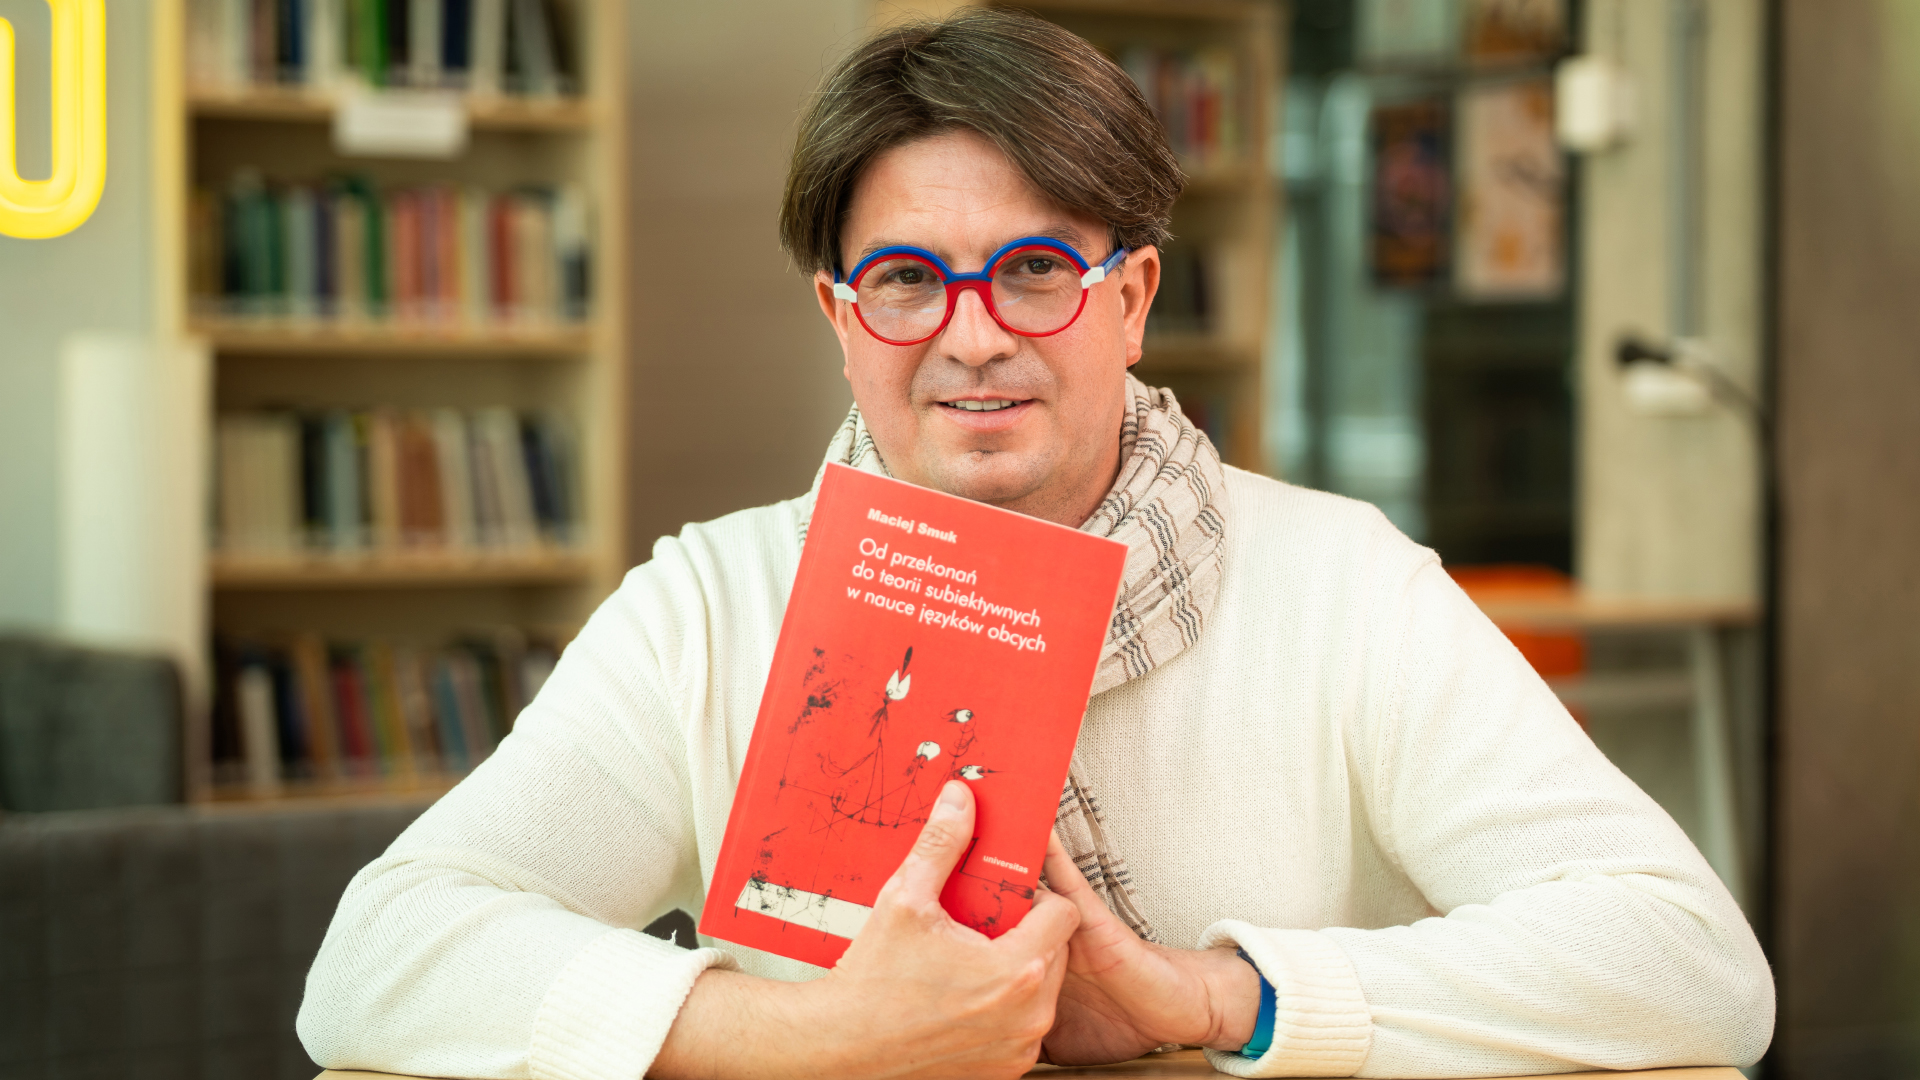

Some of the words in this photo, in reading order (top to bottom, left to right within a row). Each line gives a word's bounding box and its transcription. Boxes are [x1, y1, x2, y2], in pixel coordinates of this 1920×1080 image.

[867, 508, 915, 534] Maciej
[917, 521, 958, 544] Smuk
[859, 537, 889, 560] Od
[890, 551, 978, 586] przekonań
[852, 560, 875, 580] do
[879, 569, 922, 593] teorii
[924, 584, 1041, 627] subiektywnych
[847, 586, 861, 600] w
[864, 591, 915, 616] nauce
[918, 603, 985, 635] języków
[987, 624, 1047, 653] obcych
[982, 855, 1029, 874] universitas
